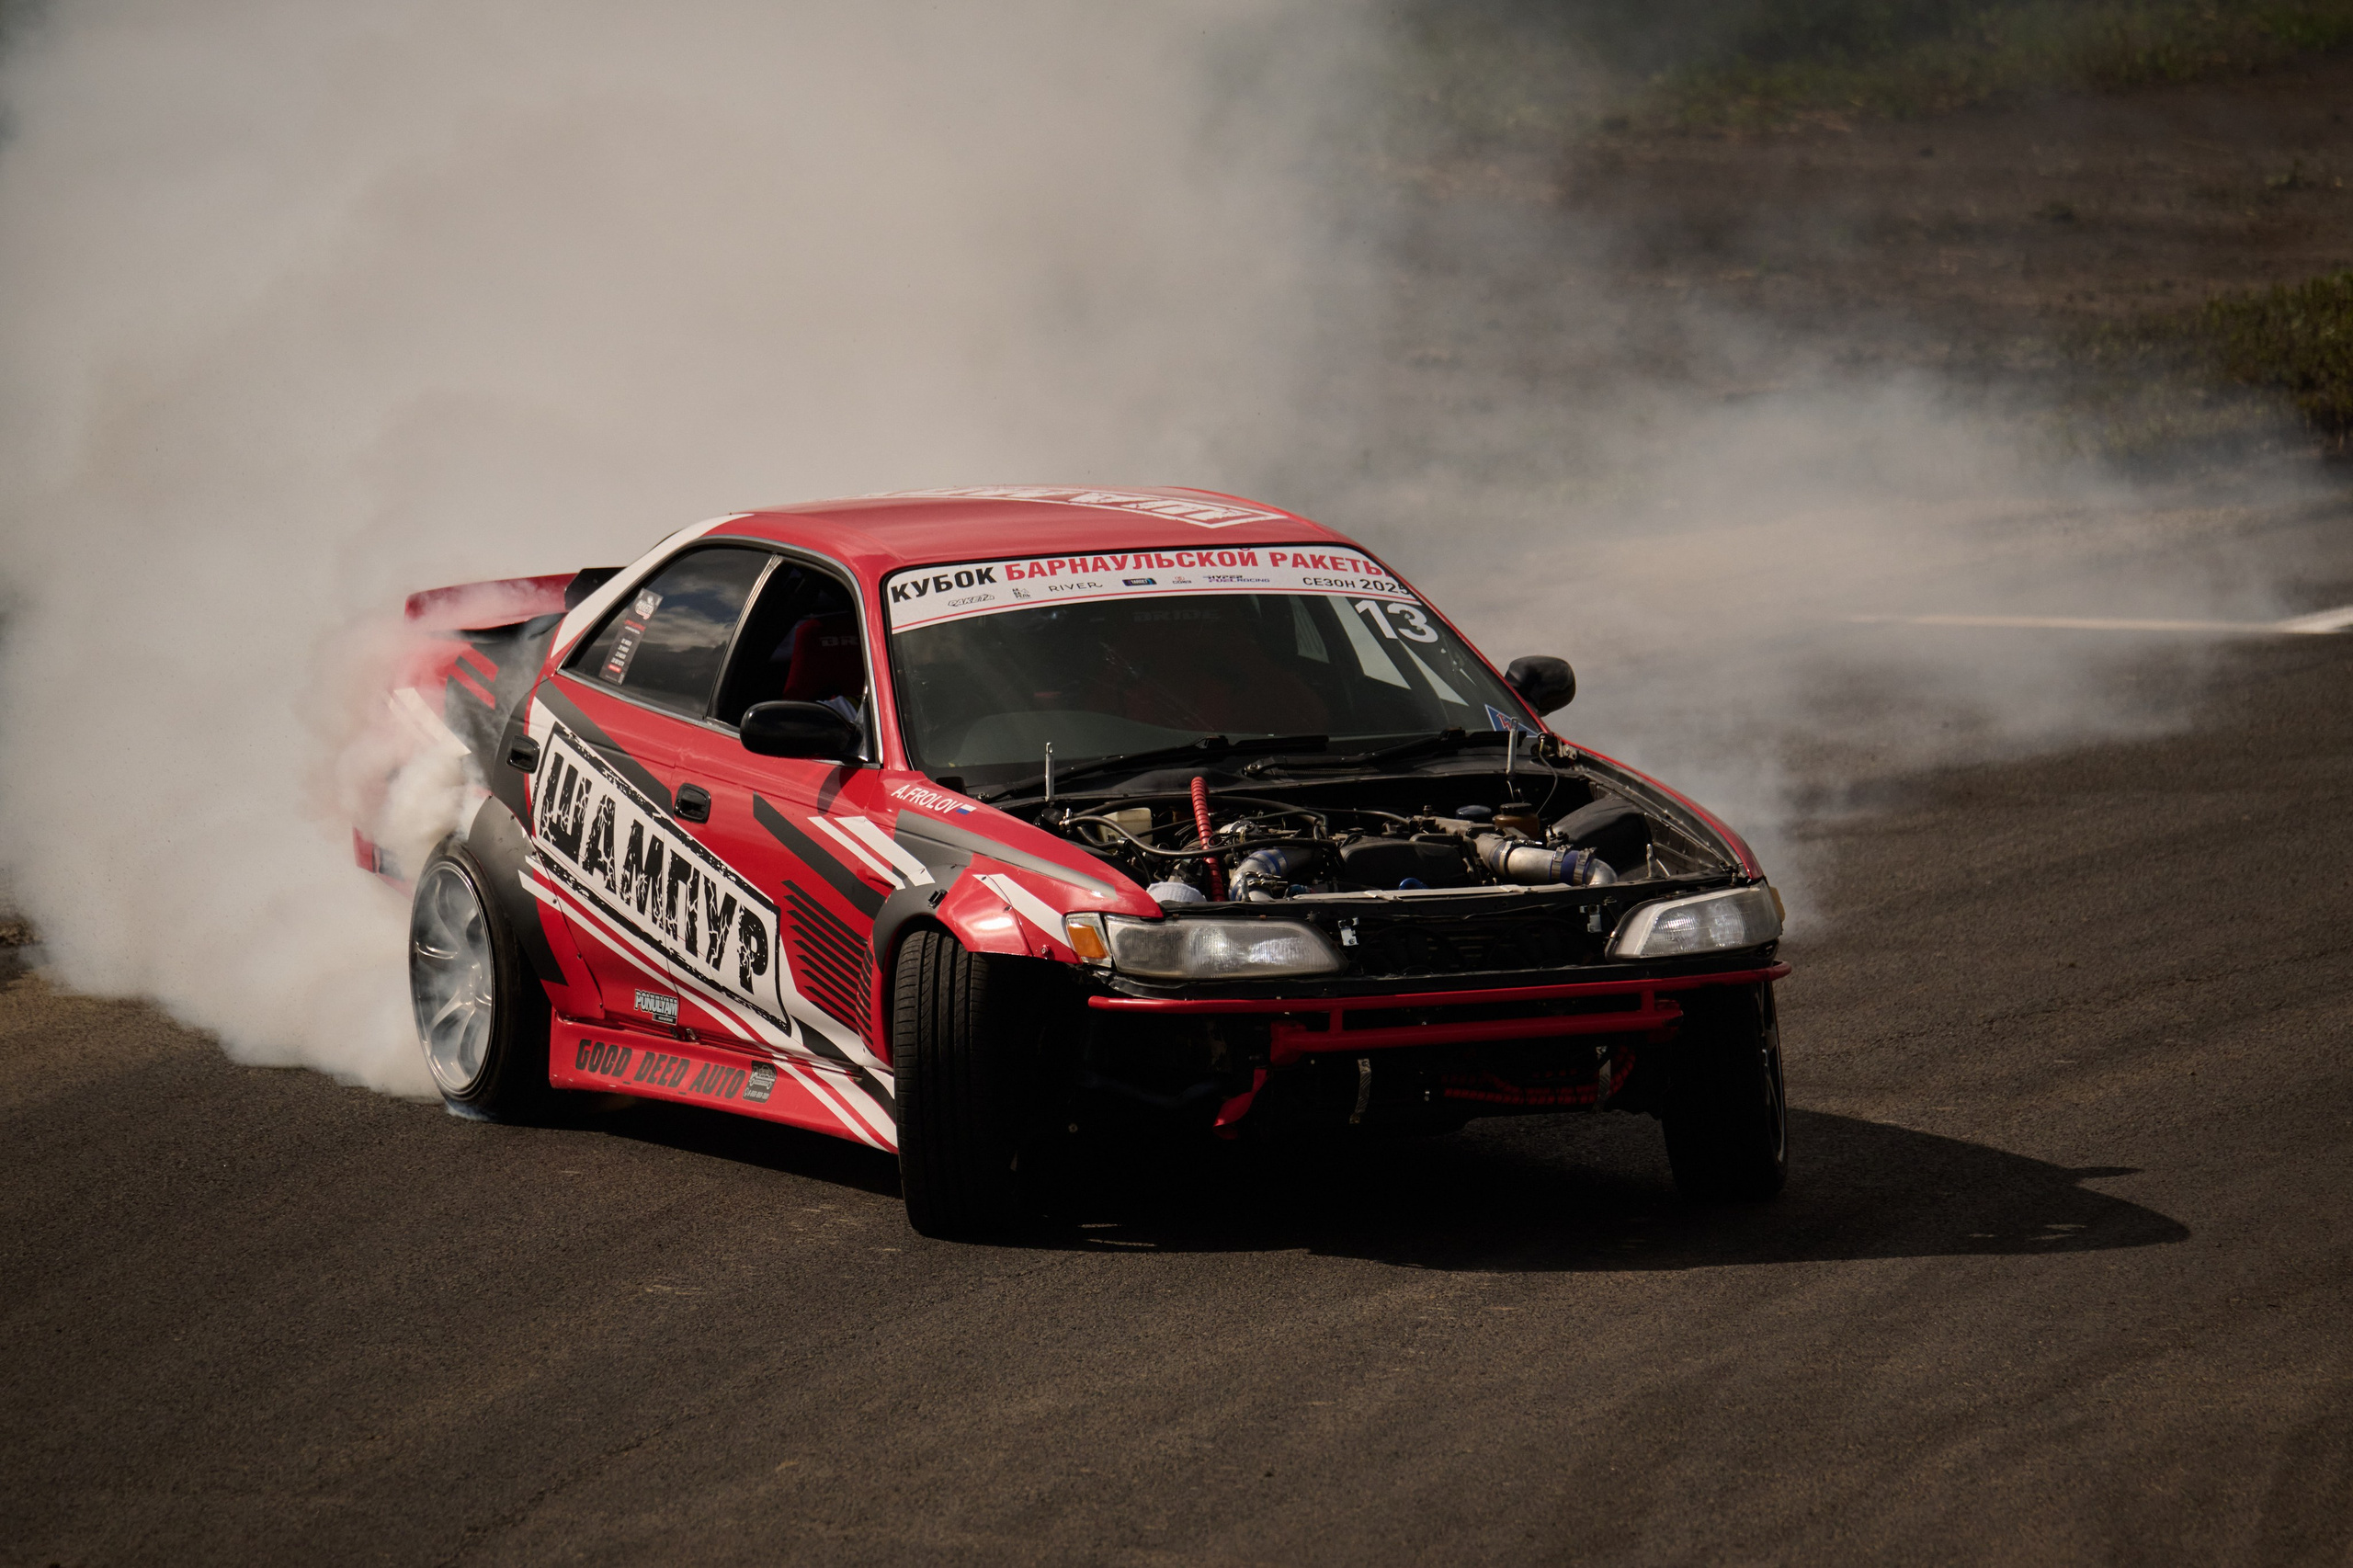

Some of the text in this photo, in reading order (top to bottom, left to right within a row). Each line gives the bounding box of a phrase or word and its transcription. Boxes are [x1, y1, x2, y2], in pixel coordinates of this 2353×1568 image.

[890, 566, 998, 604] КУБОК
[1004, 548, 1259, 582] БАРНАУЛЬСКОЙ
[1048, 581, 1104, 593] RIVER
[1302, 576, 1412, 596] СЕЗОН 2025
[1354, 599, 1439, 643] 13
[891, 784, 963, 814] A.FROLOV
[540, 751, 770, 994] ШАМПУР
